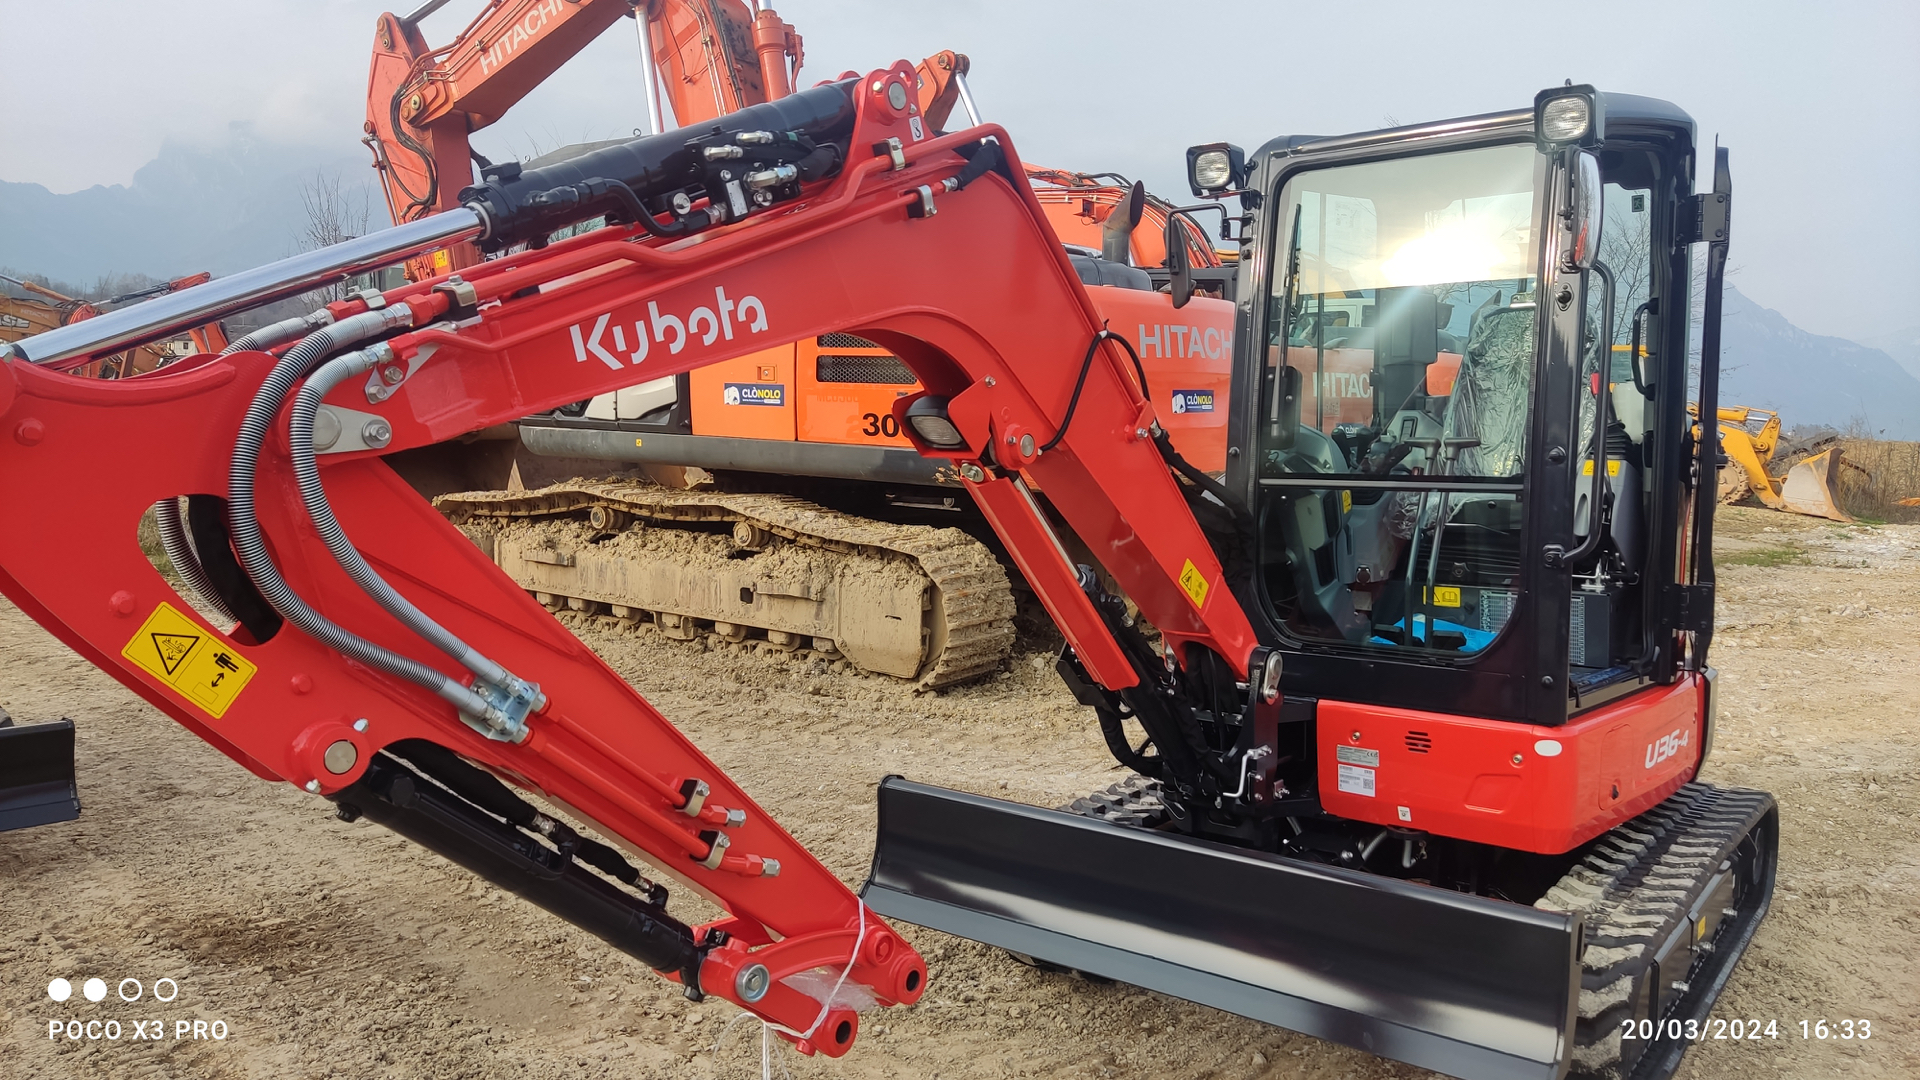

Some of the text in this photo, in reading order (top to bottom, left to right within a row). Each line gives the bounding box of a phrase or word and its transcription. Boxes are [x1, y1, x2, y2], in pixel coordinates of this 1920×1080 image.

[480, 0, 564, 75] HITACHI
[0, 314, 30, 328] SE
[569, 285, 769, 371] Kubota
[1138, 323, 1233, 360] HITACH
[1312, 371, 1374, 398] HITAC
[862, 412, 909, 438] 30
[1644, 728, 1689, 769] U36-4
